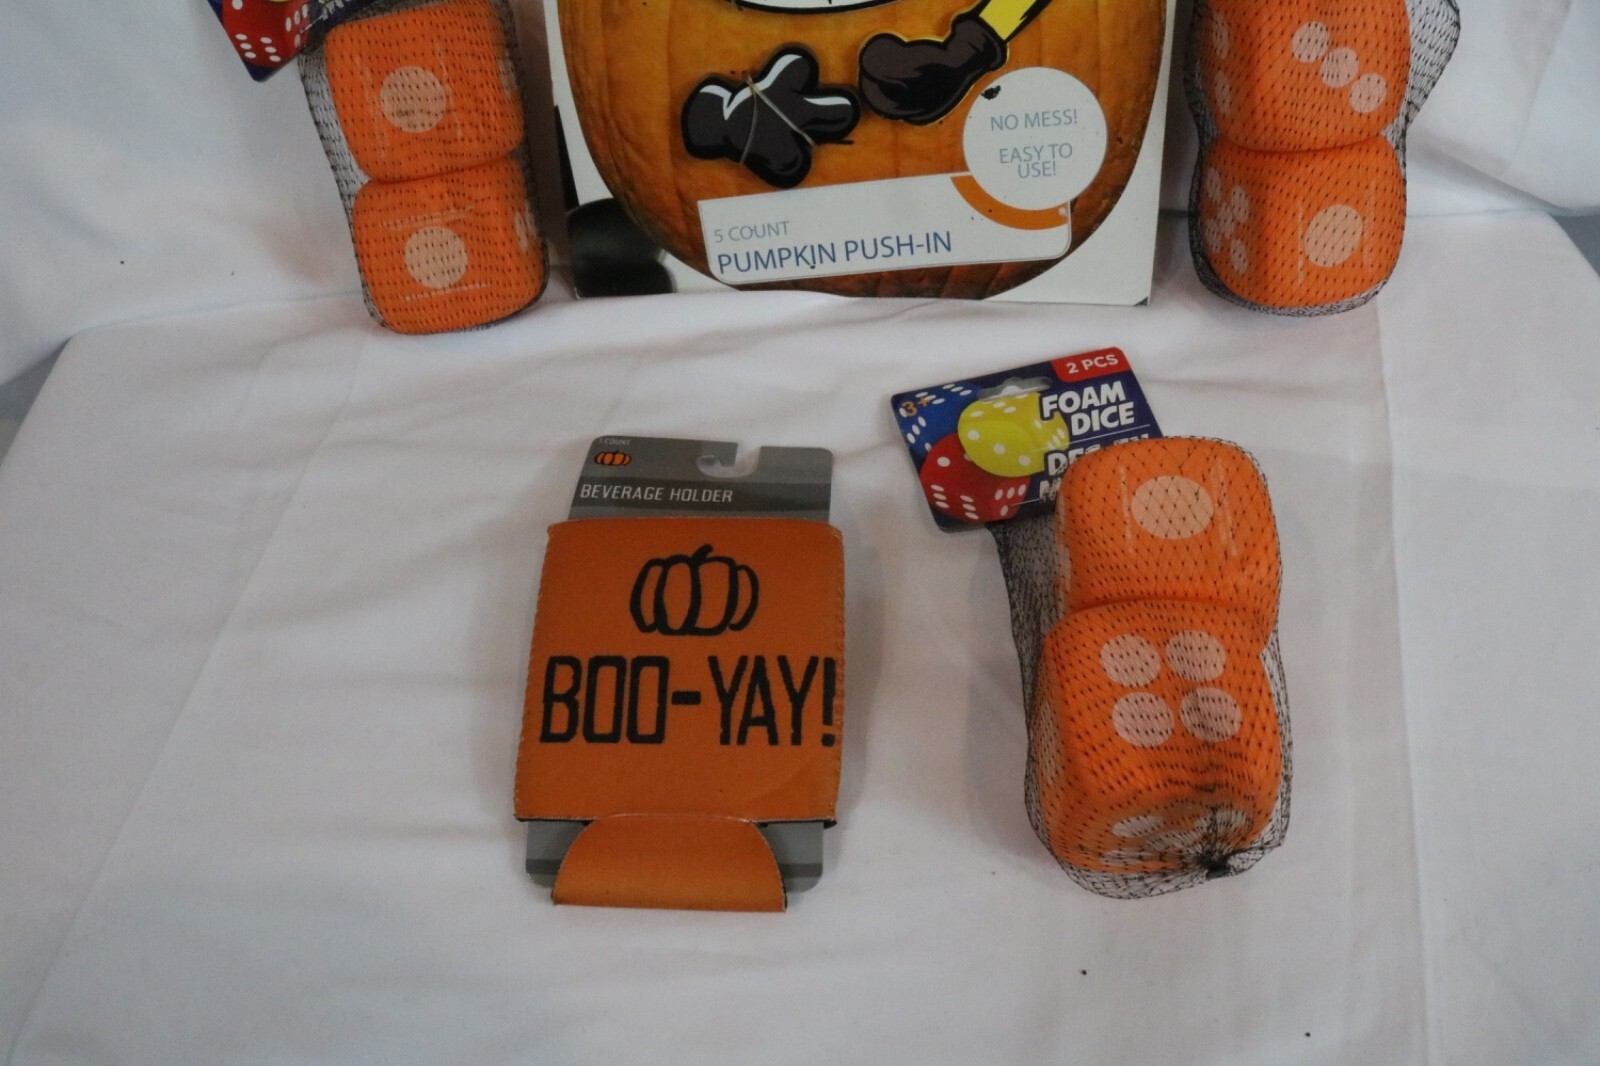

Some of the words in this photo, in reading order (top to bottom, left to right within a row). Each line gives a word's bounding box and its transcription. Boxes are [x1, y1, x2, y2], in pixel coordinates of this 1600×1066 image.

[990, 112, 1020, 132] NO
[1023, 109, 1078, 130] MESS!
[999, 146, 1046, 165] EASY
[1049, 142, 1073, 160] TO
[1017, 160, 1057, 180] USE!
[714, 229, 725, 243] 5
[728, 221, 790, 242] COUNT
[717, 243, 837, 275] PUMPKIN
[844, 231, 952, 262] PUSH-IN
[1066, 361, 1080, 375] 2
[1082, 354, 1119, 371] PCS
[1041, 380, 1126, 419] FOAM
[1070, 402, 1135, 436] DICE
[579, 483, 664, 501] BEVERAGE
[669, 489, 734, 503] HOLDER
[539, 655, 836, 746] BOO-YAY!
